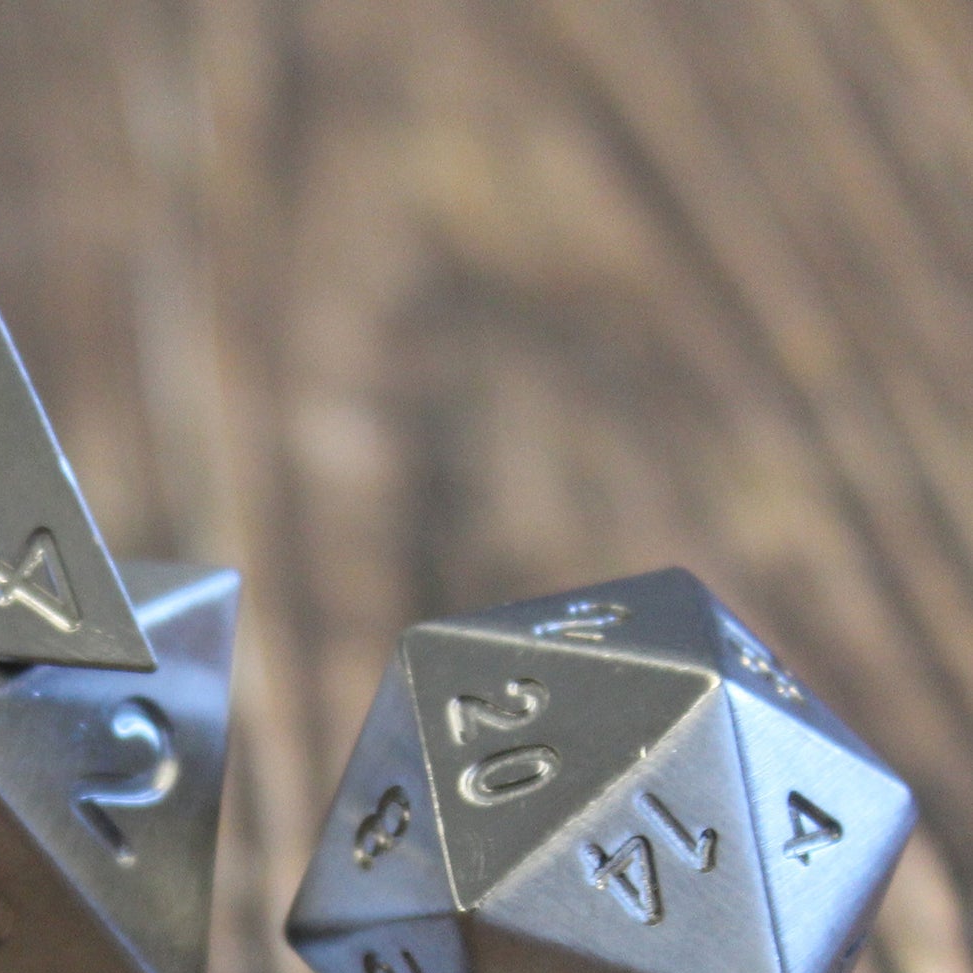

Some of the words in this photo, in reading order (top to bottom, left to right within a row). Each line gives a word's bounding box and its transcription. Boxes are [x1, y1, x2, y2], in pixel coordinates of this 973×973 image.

[73, 697, 180, 868] 2
[446, 678, 560, 805] 20
[352, 785, 411, 871] 8
[580, 792, 717, 926] 14
[781, 790, 844, 867] 4
